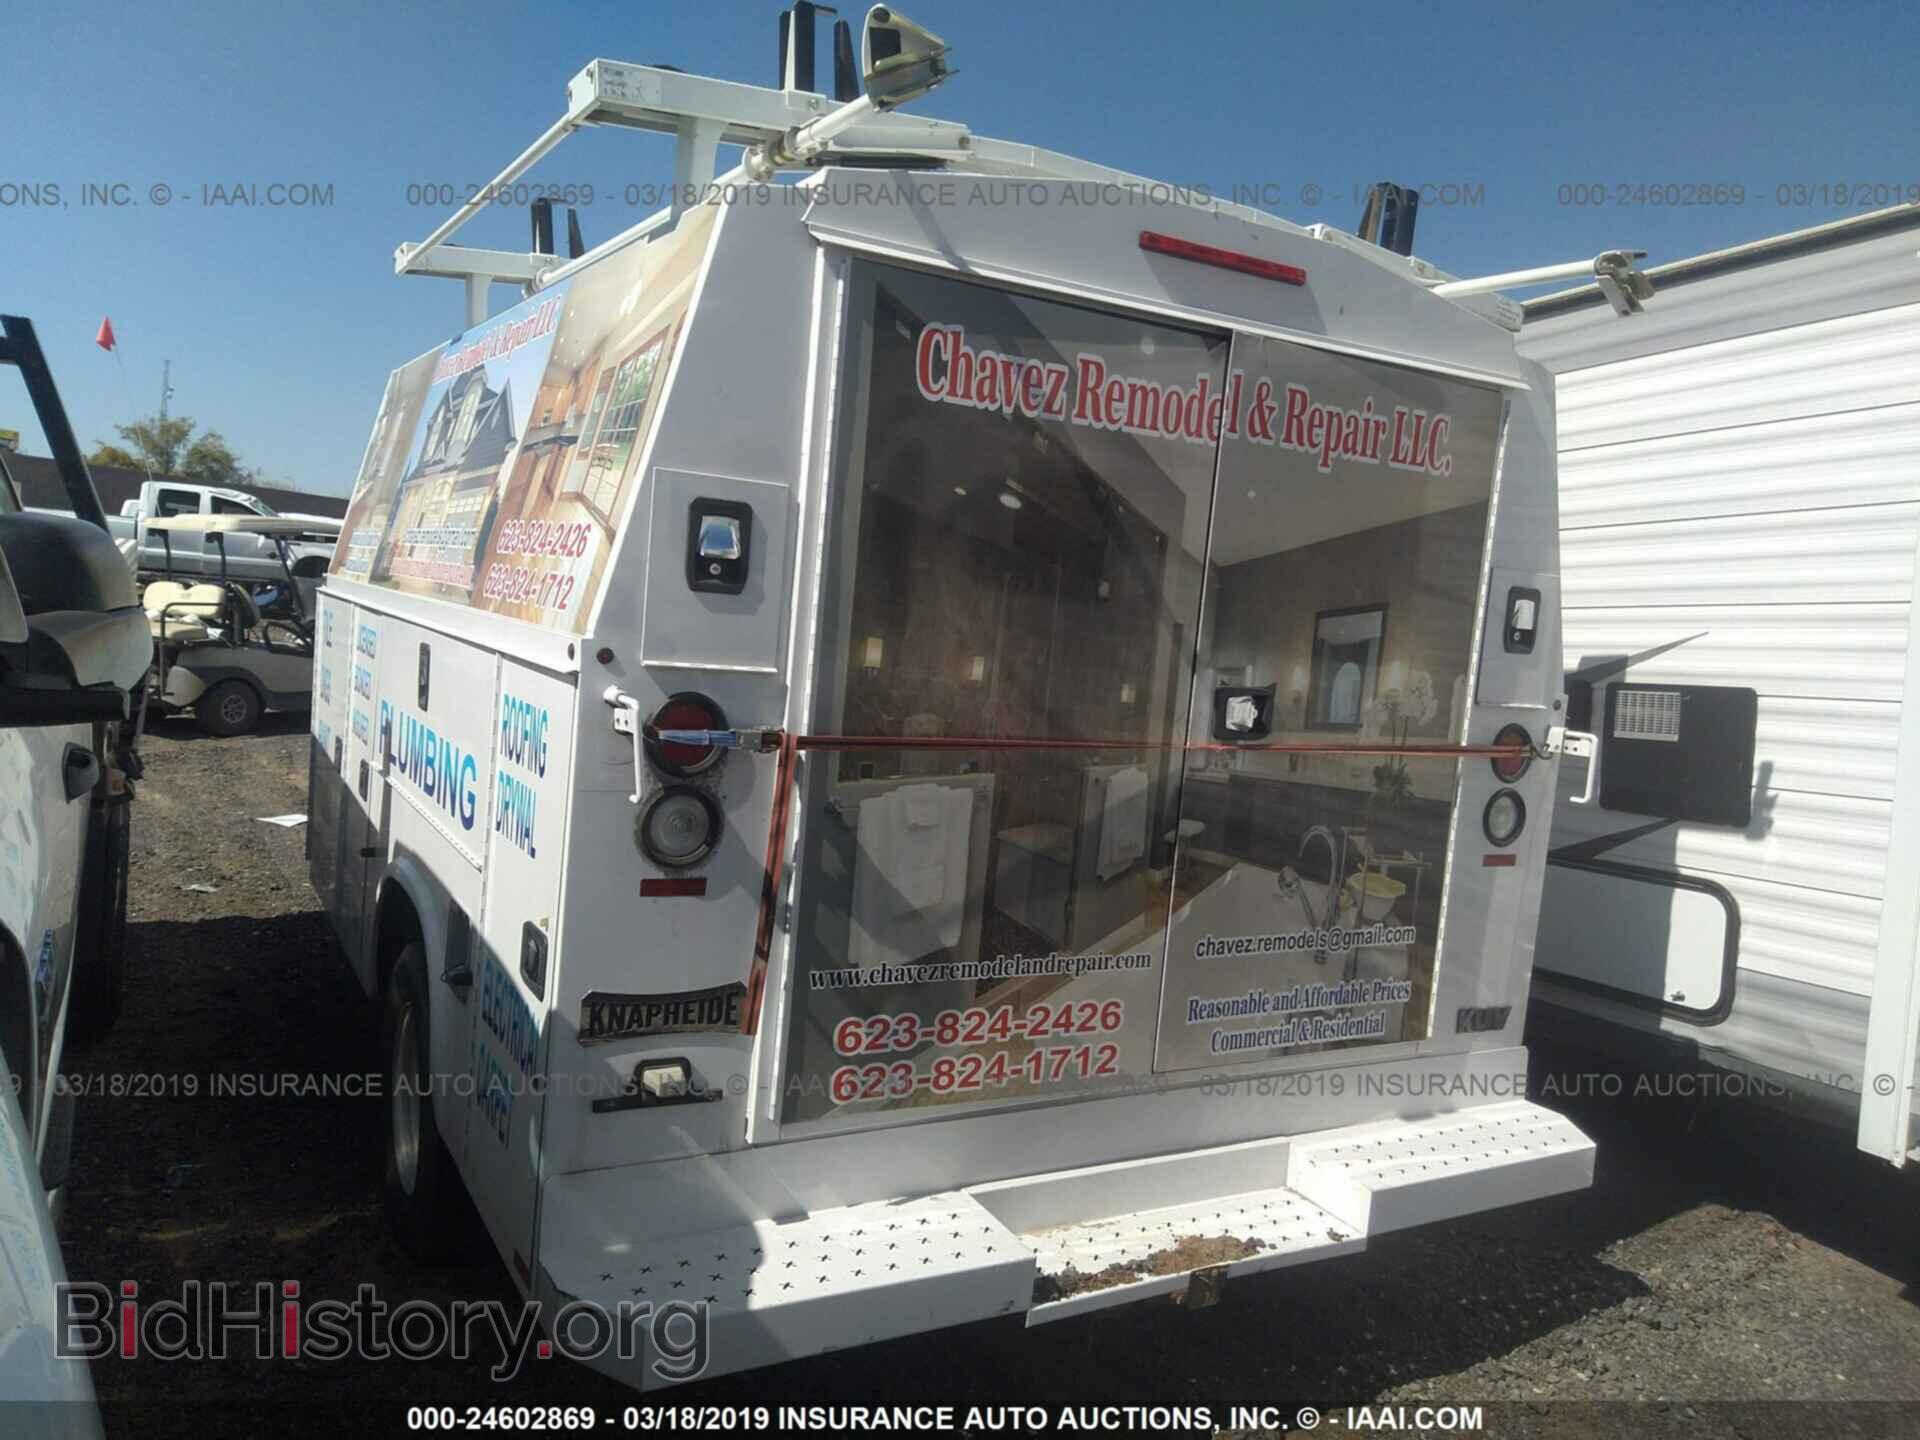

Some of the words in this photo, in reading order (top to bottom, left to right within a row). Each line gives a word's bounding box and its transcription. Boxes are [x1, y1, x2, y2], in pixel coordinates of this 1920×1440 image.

[917, 324, 1067, 419] Chavez
[1073, 354, 1243, 445] Remodel
[1248, 379, 1277, 441] &
[1281, 385, 1388, 471] Repair
[1389, 401, 1452, 476] LLC.
[496, 520, 592, 558] 623-824-2426
[483, 563, 575, 611] 623-824-1712
[500, 693, 548, 779] ROOFING
[378, 699, 477, 831] PLUMBING
[1195, 925, 1416, 958] chavez.remodels@gmail.com
[809, 953, 1152, 989] www.chavezremodelandrepair.com
[588, 992, 740, 1037] KNAPHEIDE
[1188, 990, 1269, 1023] Reasonable
[1272, 988, 1302, 1011] and
[1301, 978, 1370, 1009] Affordable
[1371, 976, 1413, 1003] Prices
[834, 1000, 1124, 1055] 623-824-2426
[1210, 1020, 1296, 1054] Commercial
[1298, 1017, 1314, 1041] &
[1312, 1010, 1386, 1040] Residential
[830, 1043, 1120, 1103] 623-824-1712
